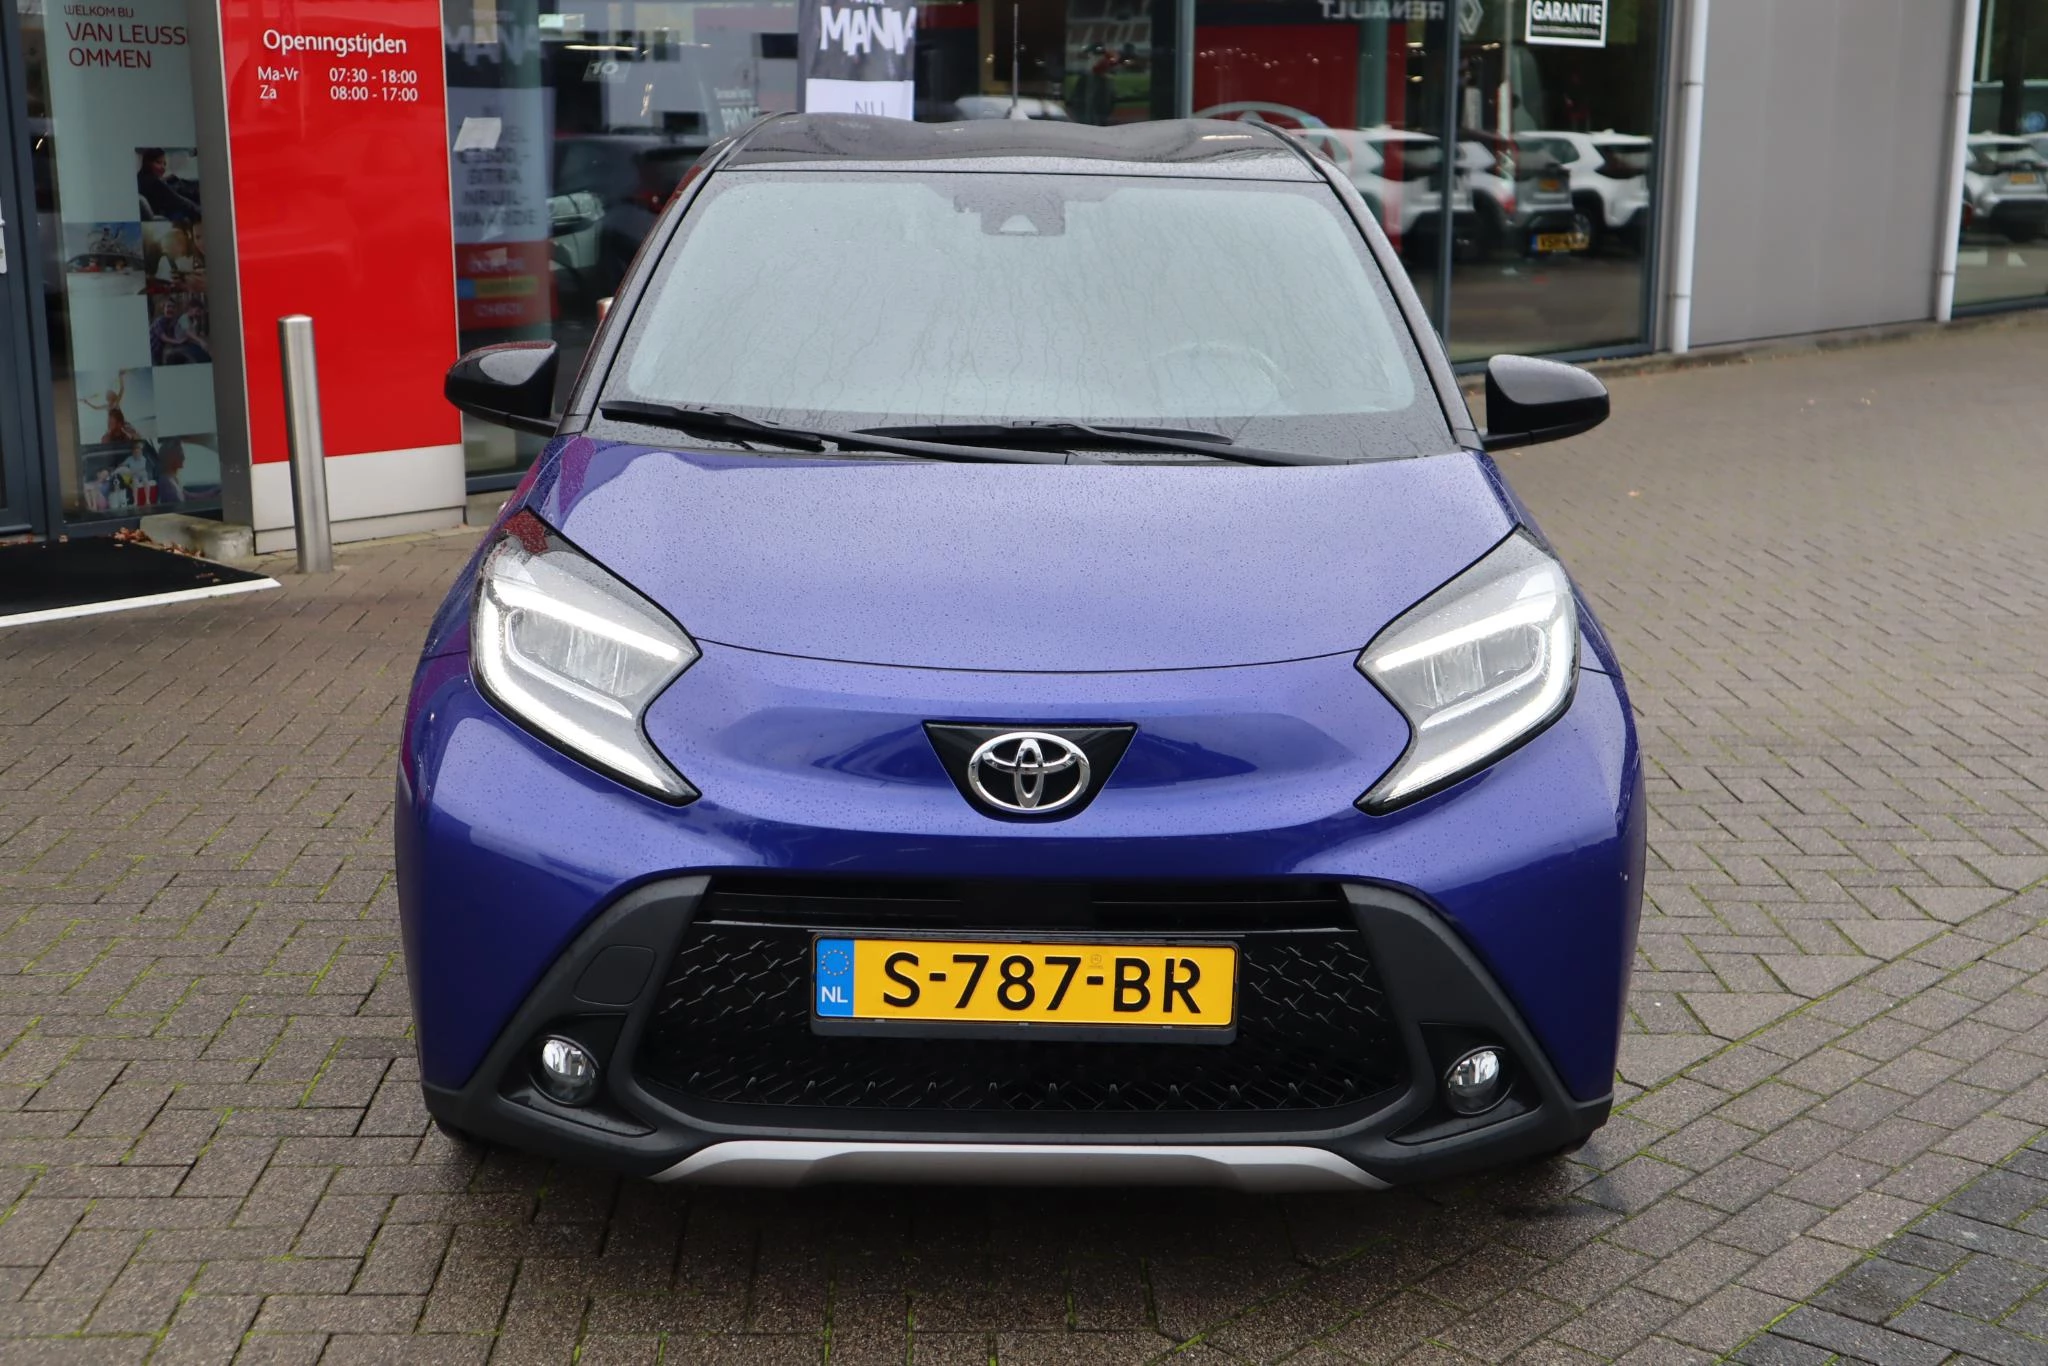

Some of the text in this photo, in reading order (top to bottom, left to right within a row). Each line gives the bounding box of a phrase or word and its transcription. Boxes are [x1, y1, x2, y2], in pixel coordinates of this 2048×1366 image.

[64, 5, 115, 17] WELKOM
[1532, 0, 1601, 25] GARANTIE
[65, 22, 190, 45] VAN LEUSS
[263, 29, 407, 58] Openingstijden
[69, 48, 152, 68] OMMEN
[257, 66, 299, 81] Ma-Vr
[329, 68, 368, 82] 07:30
[380, 69, 418, 84] 18:00
[260, 85, 277, 99] Za
[330, 86, 369, 100] 08:00
[382, 87, 419, 101] 17:00
[883, 951, 1202, 1014] S-787-BR
[821, 985, 848, 1004] NL
